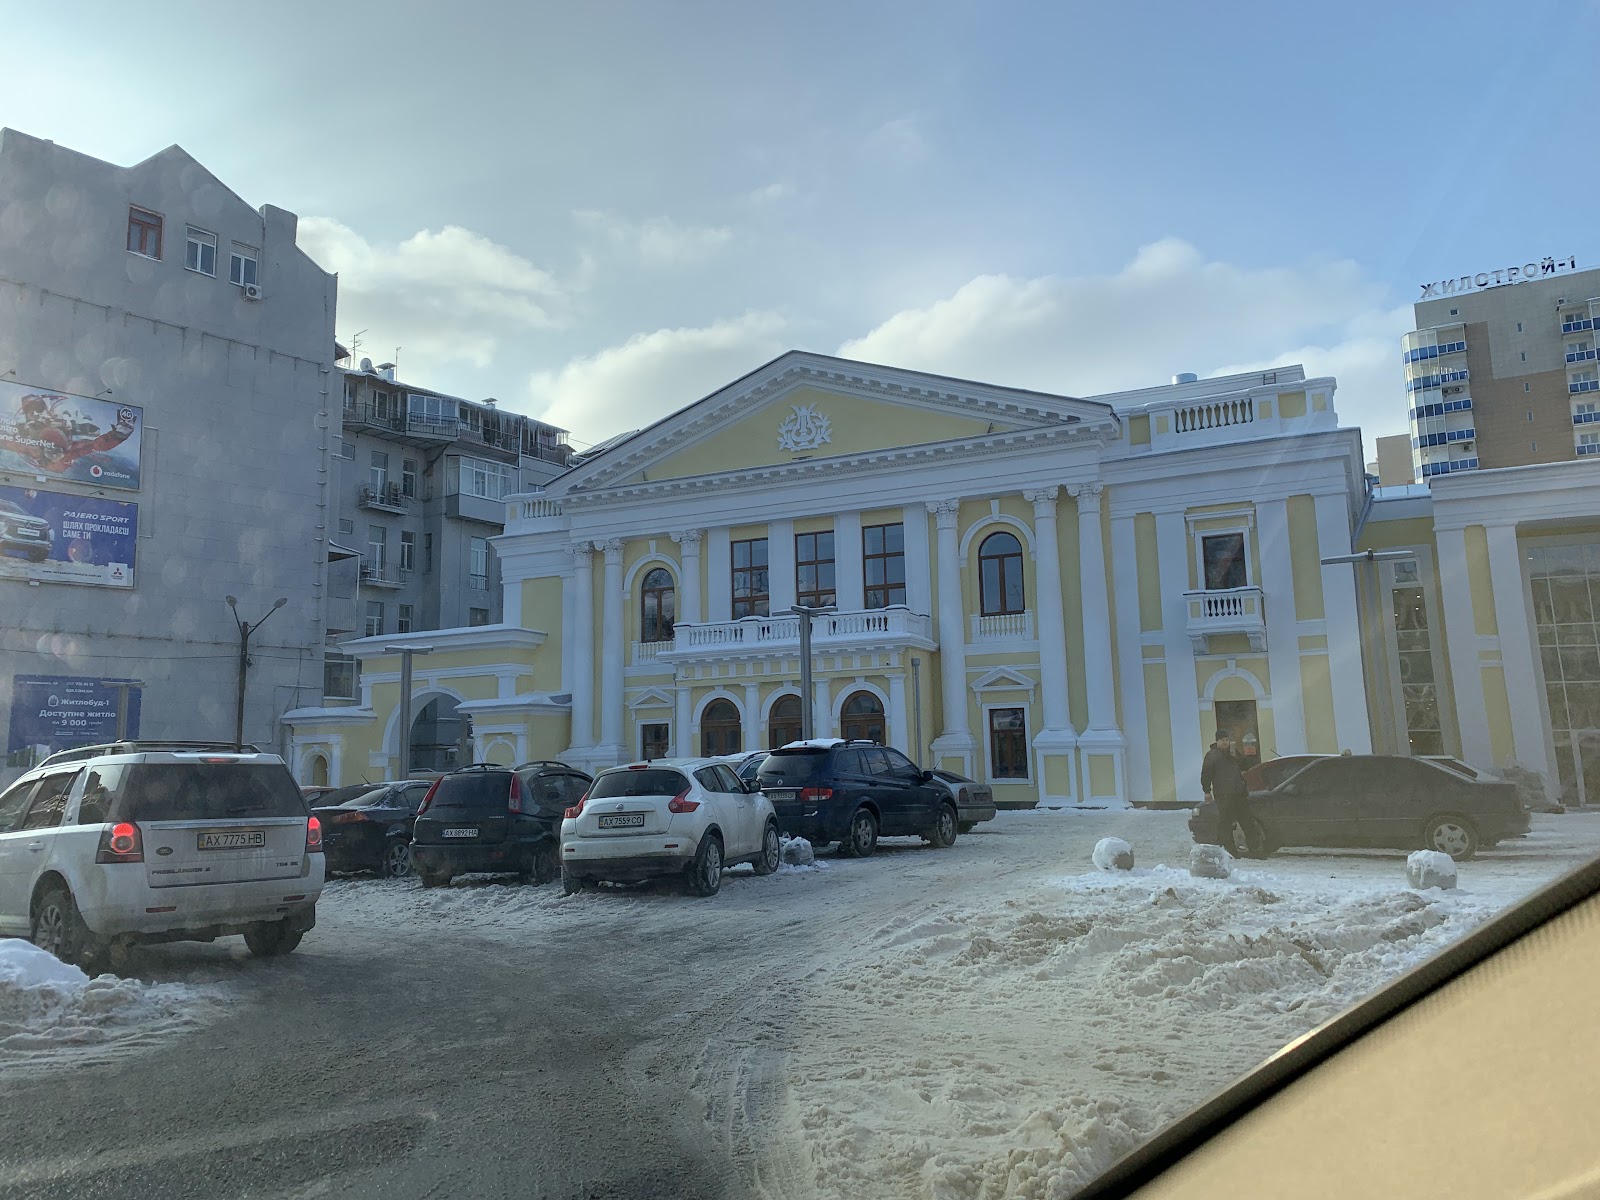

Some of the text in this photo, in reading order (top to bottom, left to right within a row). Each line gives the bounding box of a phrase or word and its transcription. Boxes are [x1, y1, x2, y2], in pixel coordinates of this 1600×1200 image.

[1420, 255, 1576, 298] ЖИЛСТРОЙ-1
[121, 410, 132, 418] 4G
[15, 435, 55, 449] SuperNet
[103, 471, 130, 480] vodafone
[63, 510, 130, 524] PAJERO SPORT
[62, 520, 130, 536] ШЛЯХ ПРОКЛАДАЄШ
[62, 529, 92, 540] САМЕ ТИ
[60, 698, 110, 707] Житлобуд-1
[38, 709, 85, 718] Доступне
[69, 719, 87, 727] 000
[604, 816, 642, 826] AX 7559 CO
[445, 829, 454, 837] AX
[468, 829, 477, 837] HA
[205, 833, 263, 847] AX 7775 HB
